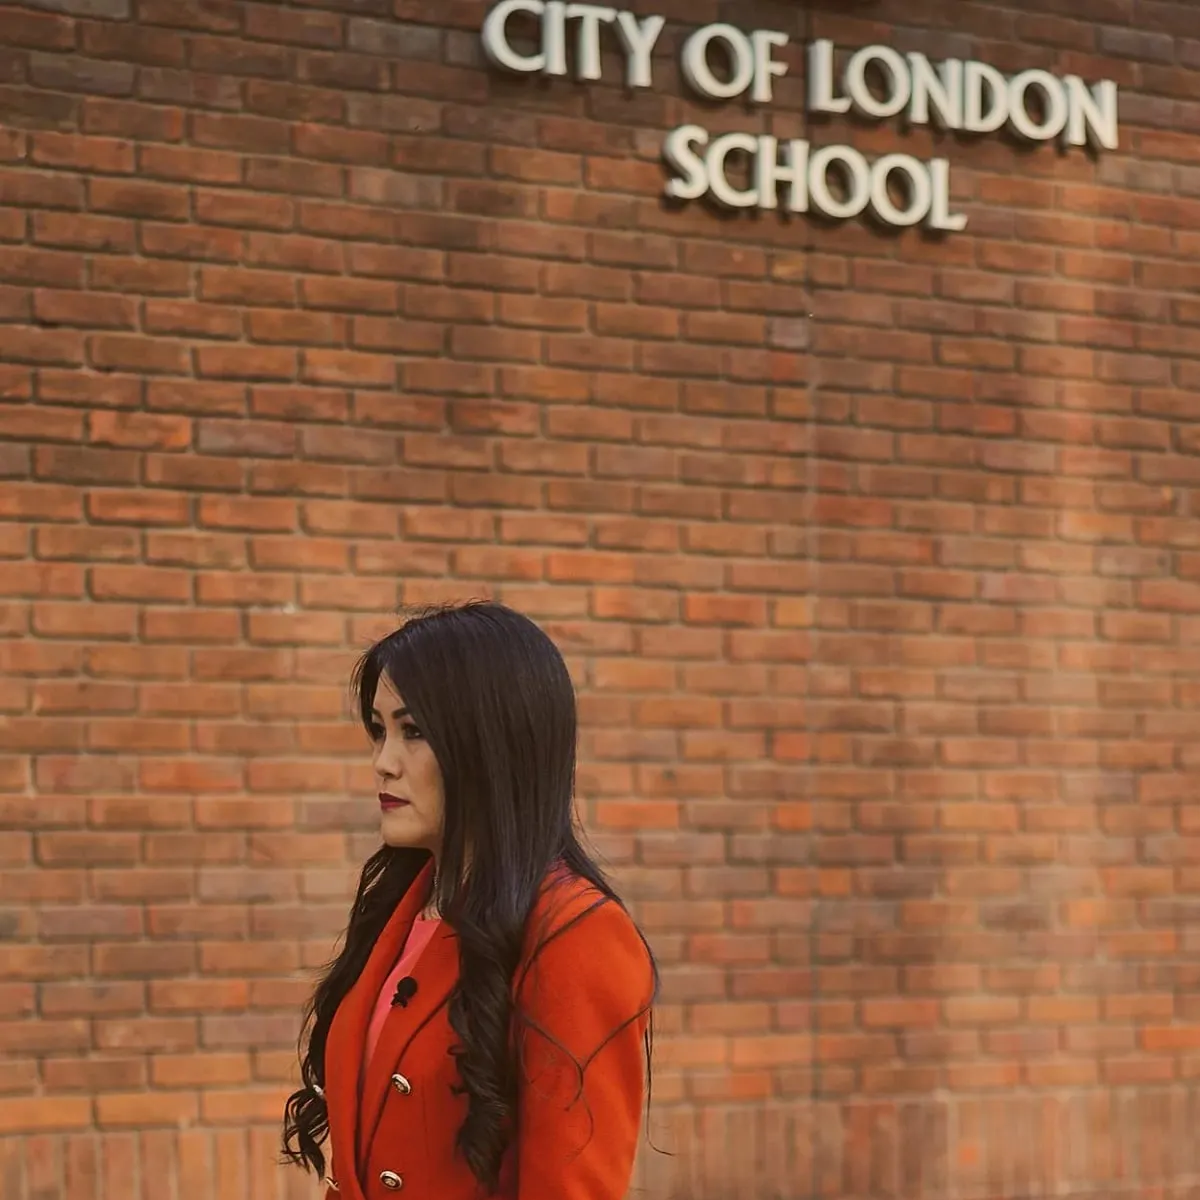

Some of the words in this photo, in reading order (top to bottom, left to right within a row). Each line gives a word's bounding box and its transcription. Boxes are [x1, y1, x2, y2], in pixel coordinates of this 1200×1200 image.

[482, 0, 665, 87] CITY
[681, 23, 788, 102] OF
[808, 38, 1118, 150] LONDON
[664, 125, 968, 231] SCHOOL
